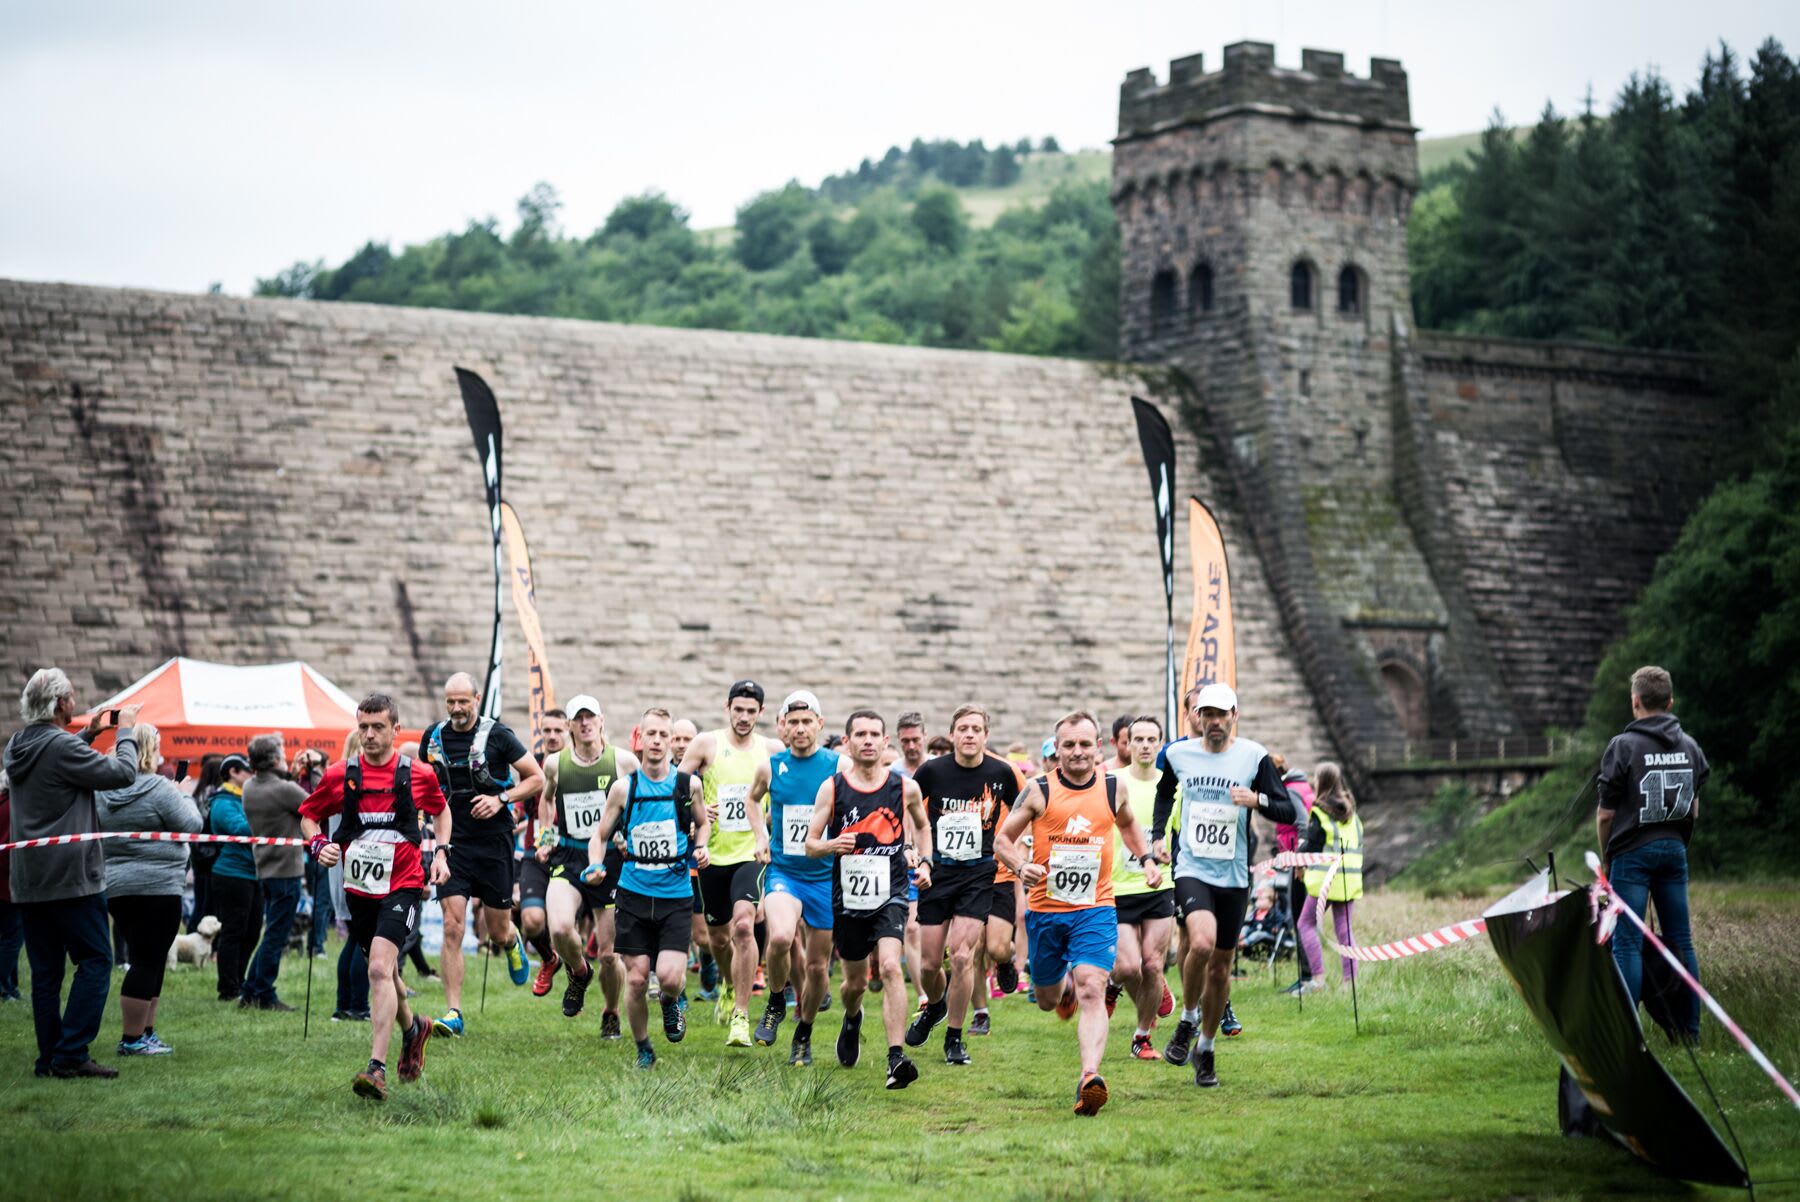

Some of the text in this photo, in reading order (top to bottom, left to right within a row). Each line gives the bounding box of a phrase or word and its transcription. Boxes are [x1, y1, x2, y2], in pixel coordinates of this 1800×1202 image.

[172, 733, 336, 749] www.acceluk.com
[1644, 752, 1689, 766] DANIEL
[941, 797, 982, 813] TOUGH
[1639, 769, 1694, 823] 17
[575, 808, 601, 829] 104
[725, 801, 746, 820] 28
[790, 824, 809, 843] 22
[945, 831, 975, 850] 274
[1195, 823, 1230, 846] 086
[639, 840, 671, 859] 083
[351, 859, 385, 881] 070
[849, 875, 879, 897] 221
[1055, 870, 1092, 893] 099
